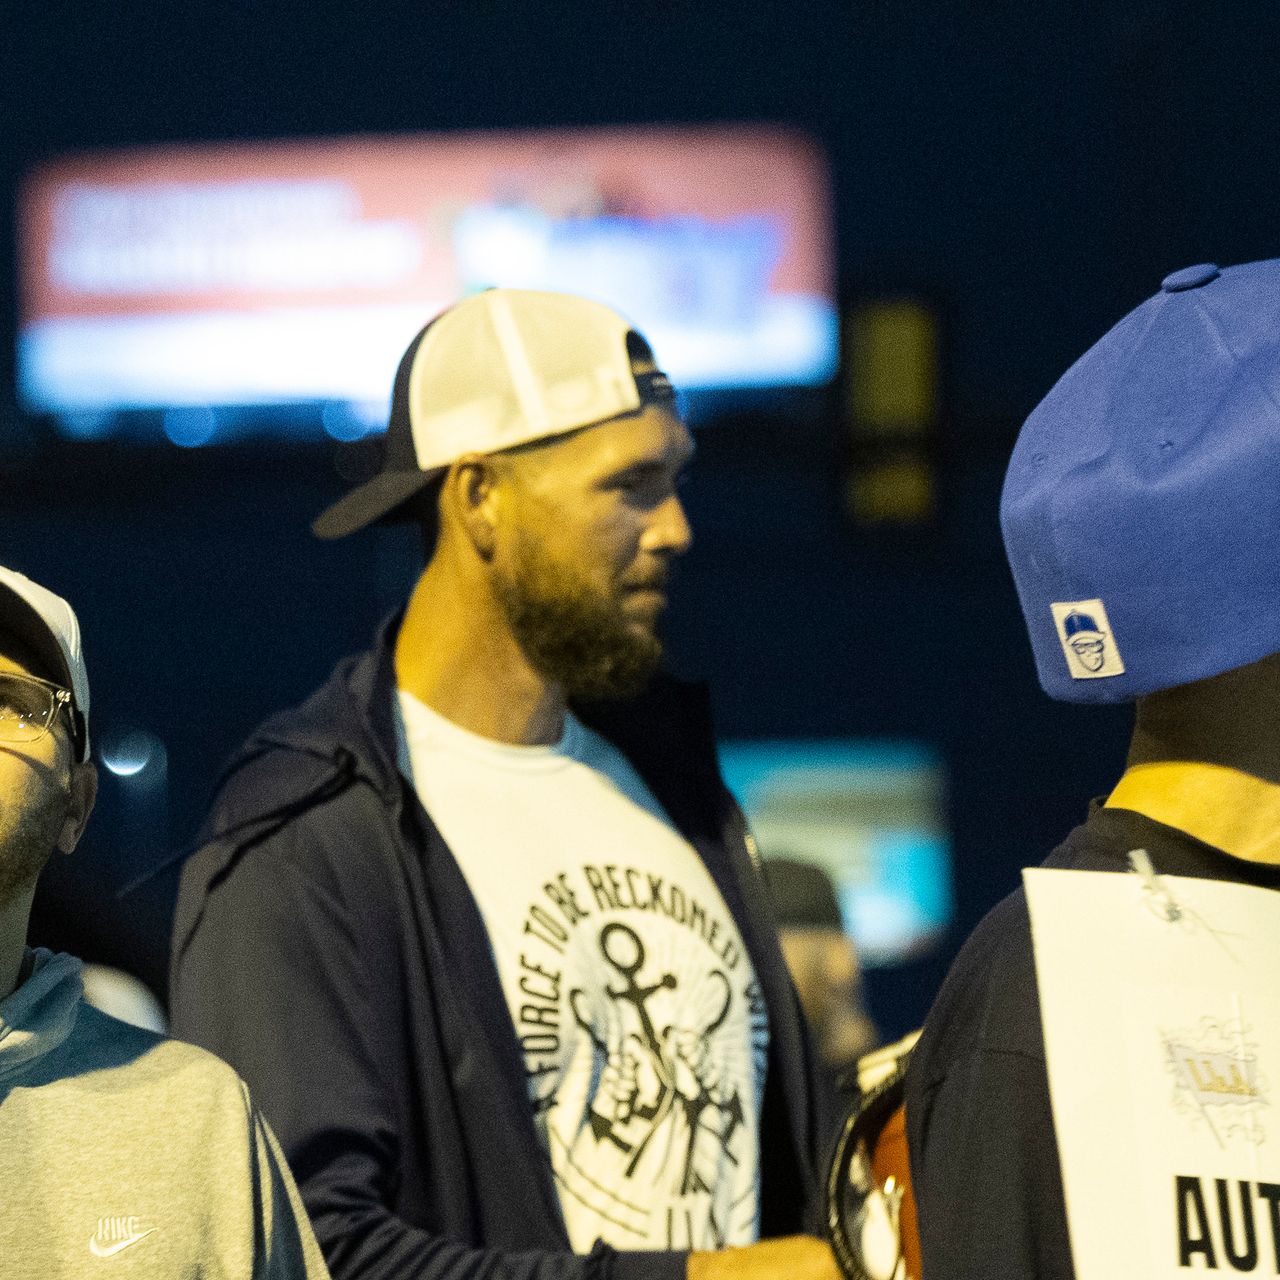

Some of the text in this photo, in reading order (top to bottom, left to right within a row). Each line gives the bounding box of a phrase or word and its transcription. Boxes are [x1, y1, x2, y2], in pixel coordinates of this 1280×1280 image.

[543, 873, 590, 926] BE
[523, 905, 568, 954] TO
[518, 953, 561, 1076] FORCE
[97, 1214, 143, 1242] NIKE
